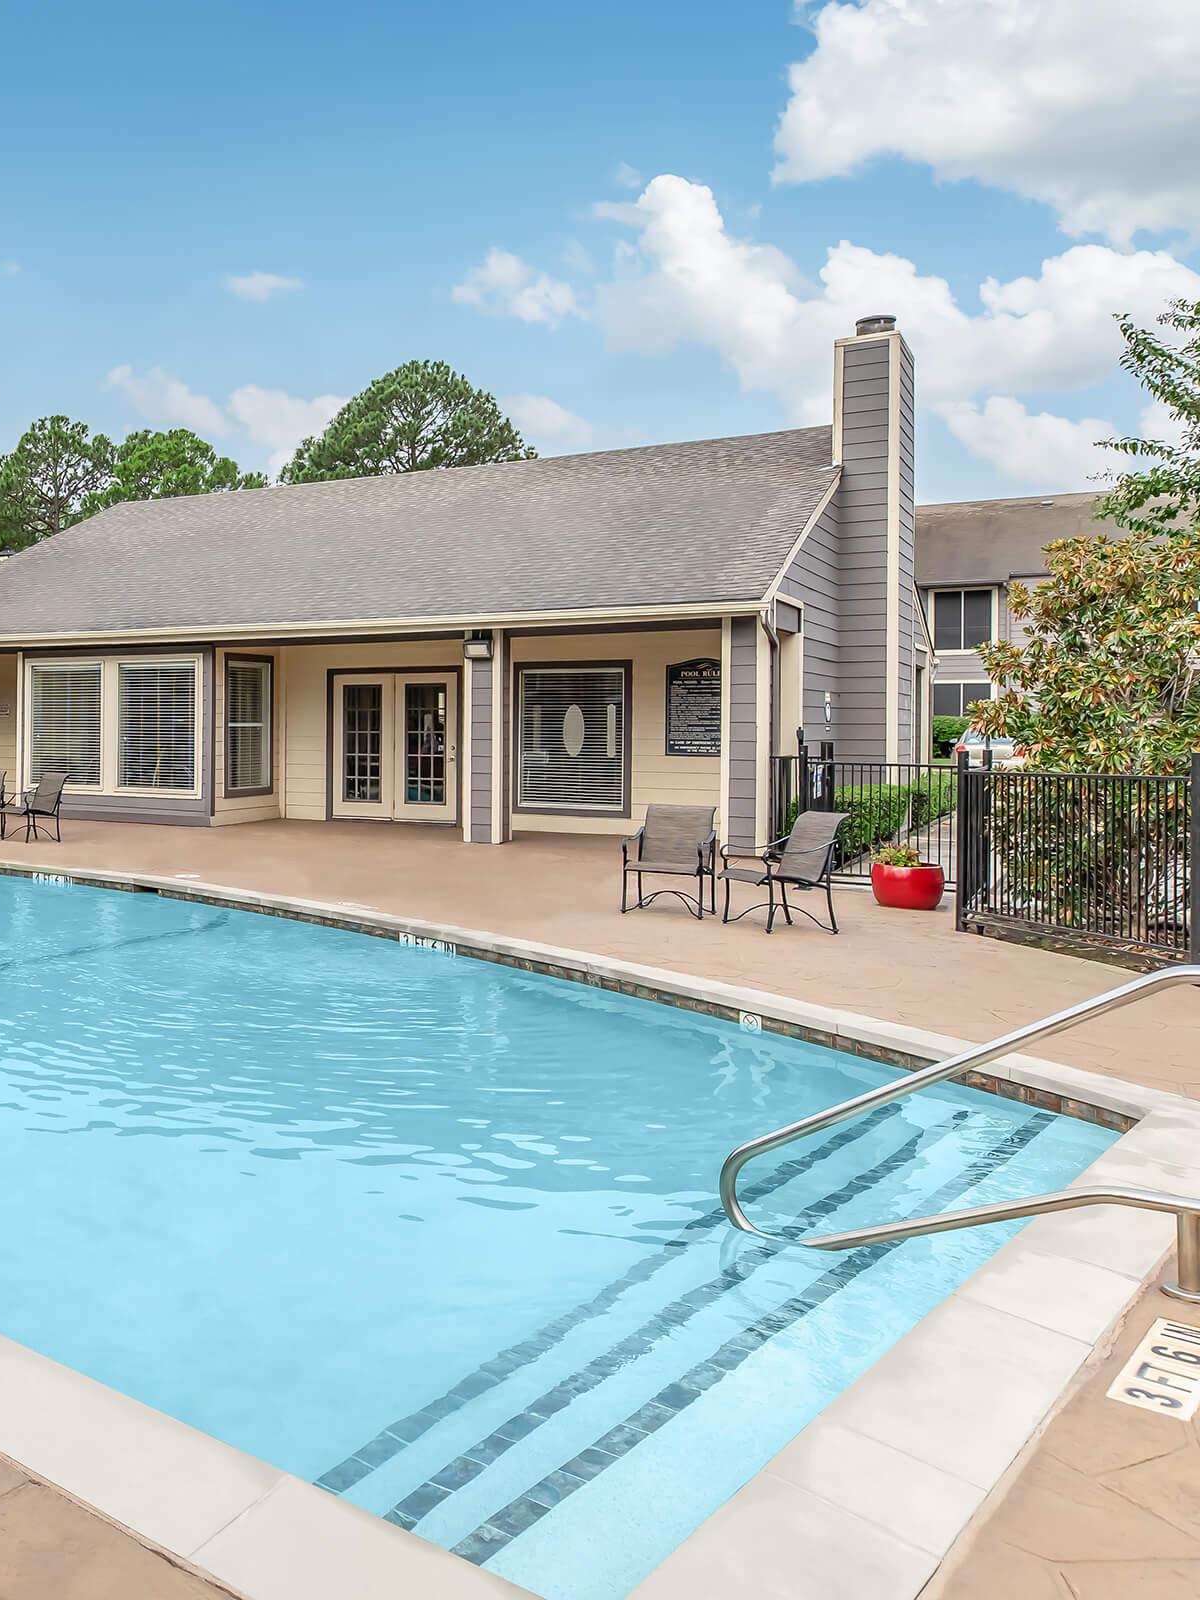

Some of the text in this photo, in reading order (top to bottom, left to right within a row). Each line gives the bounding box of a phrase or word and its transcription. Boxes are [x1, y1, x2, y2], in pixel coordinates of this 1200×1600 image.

[1125, 1323, 1200, 1408] 3 FT 6 IN
